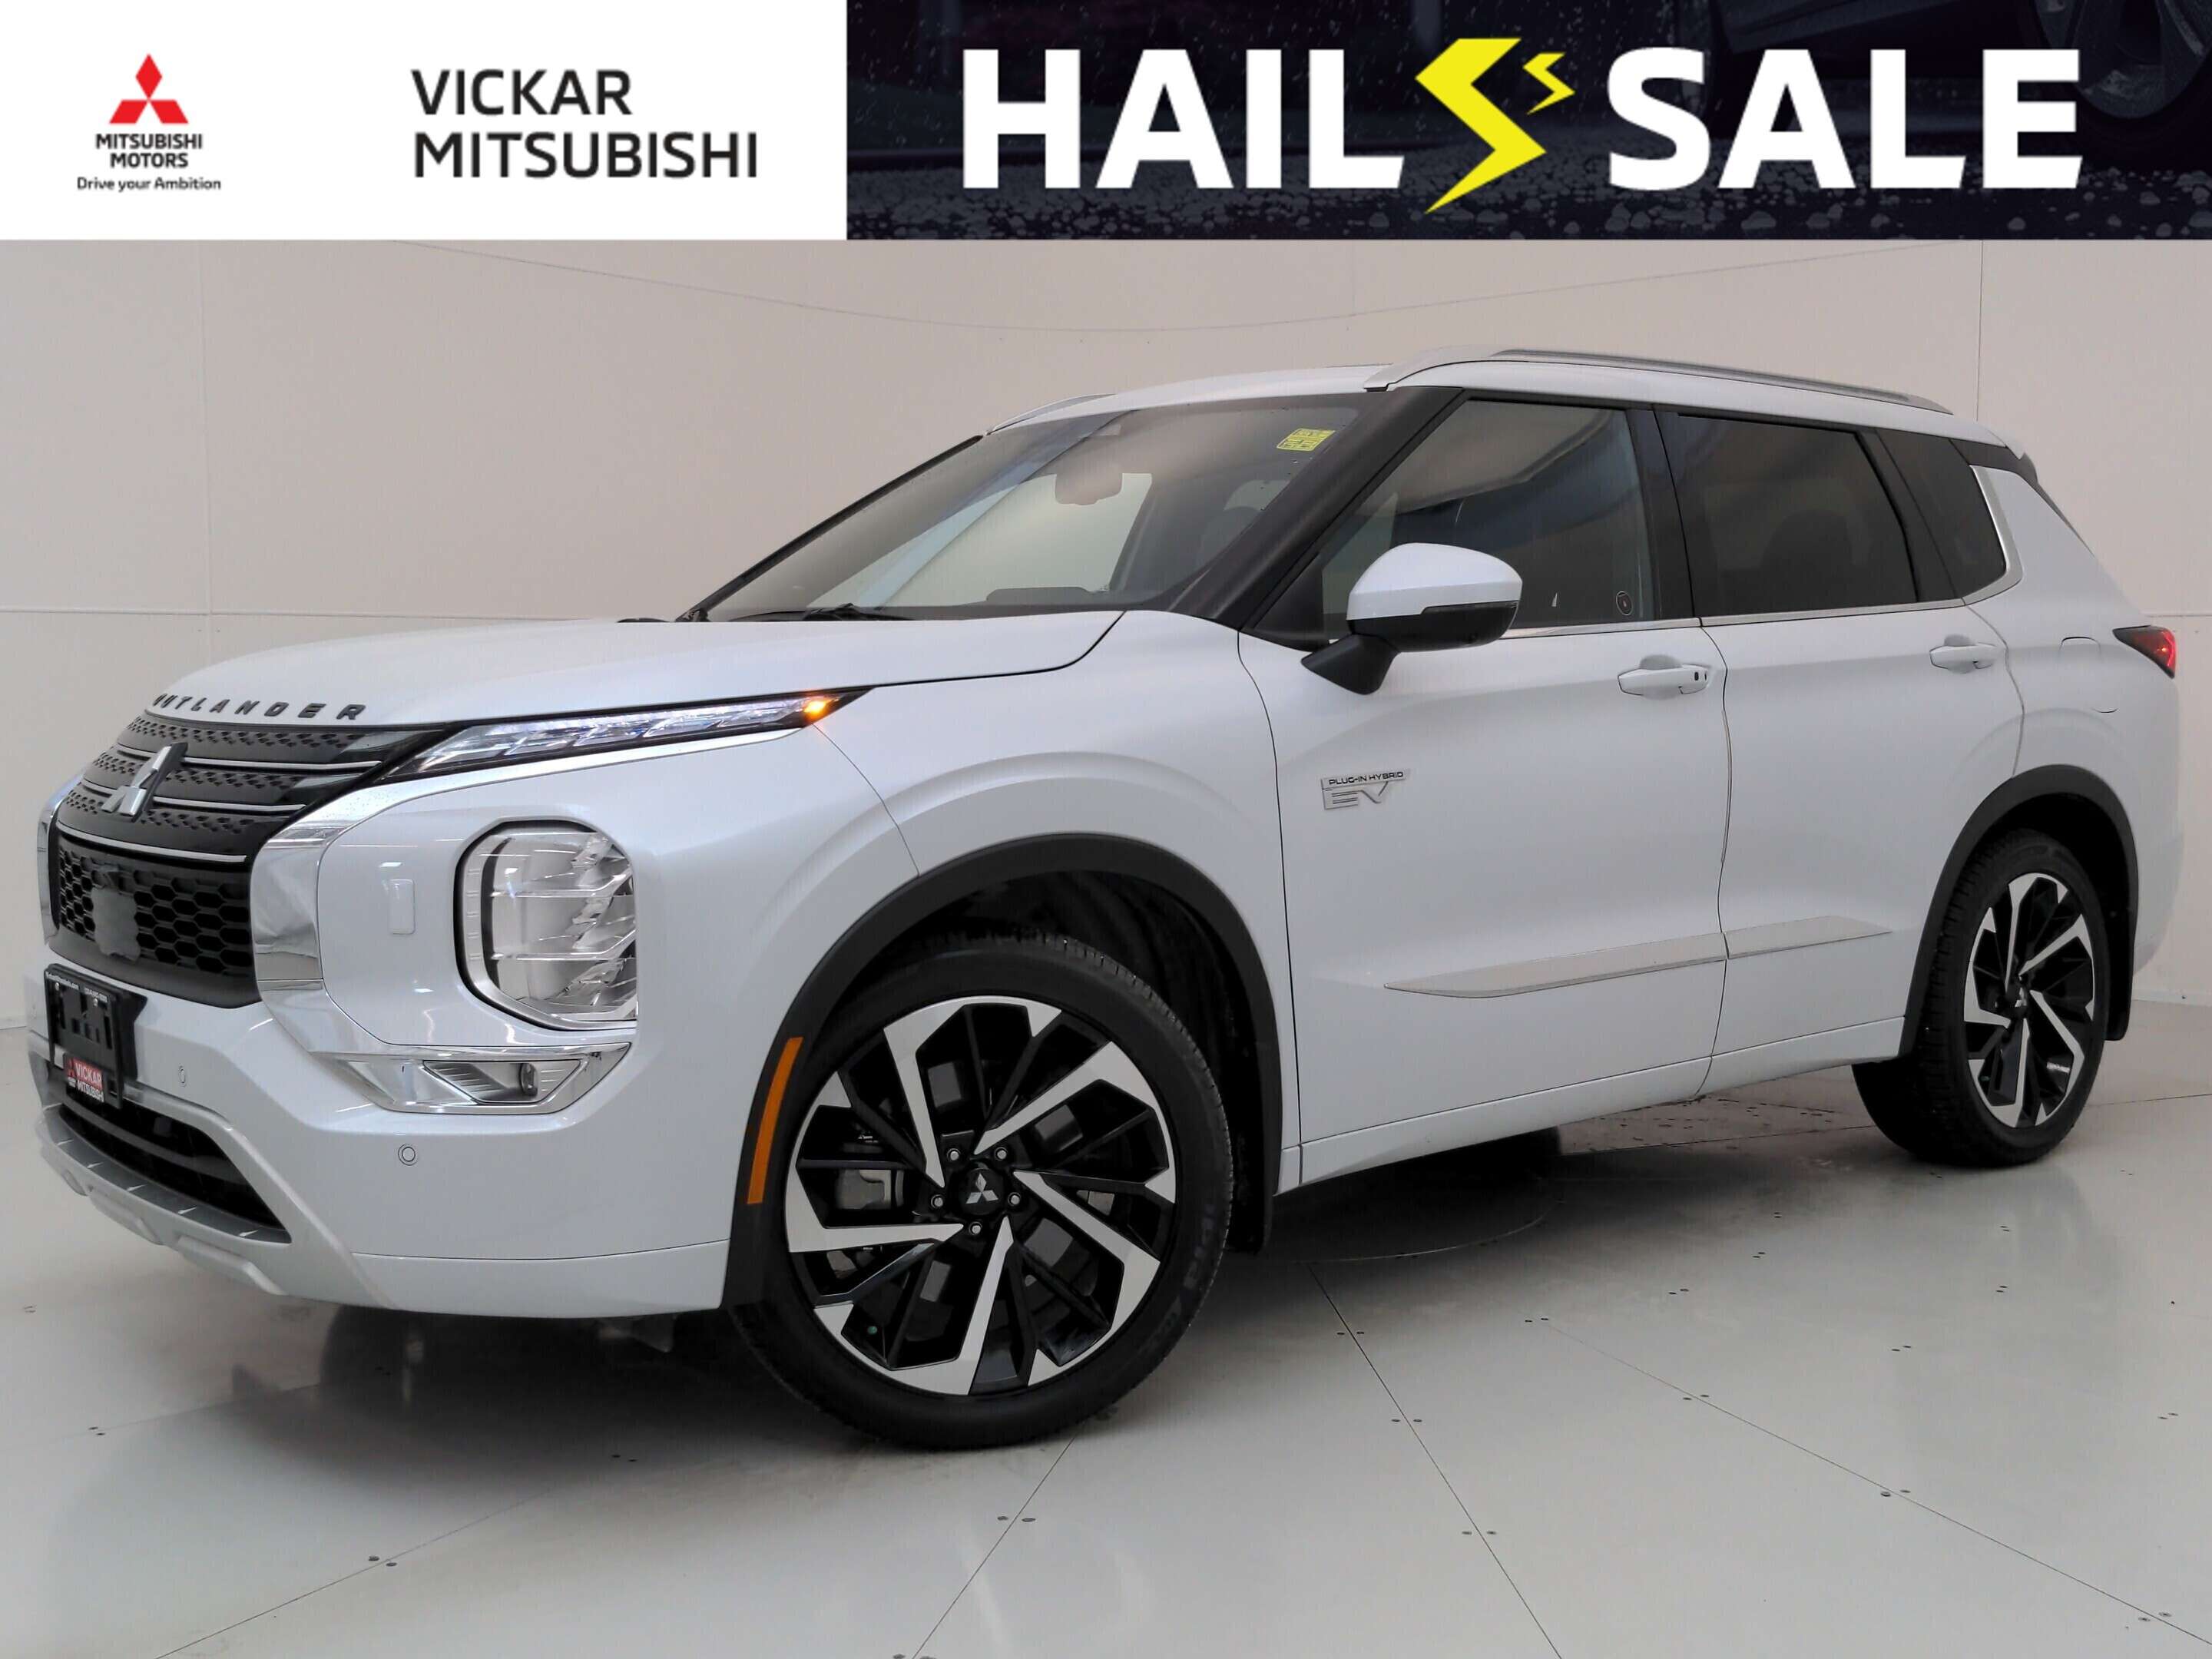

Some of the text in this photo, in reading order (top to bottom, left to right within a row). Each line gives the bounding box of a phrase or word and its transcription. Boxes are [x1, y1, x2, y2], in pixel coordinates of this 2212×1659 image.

[153, 693, 366, 720] OUTLANDER
[1329, 771, 1404, 785] PLUG-IN HYBRID
[1321, 782, 1389, 810] EV
[75, 1061, 103, 1088] VICKAR
